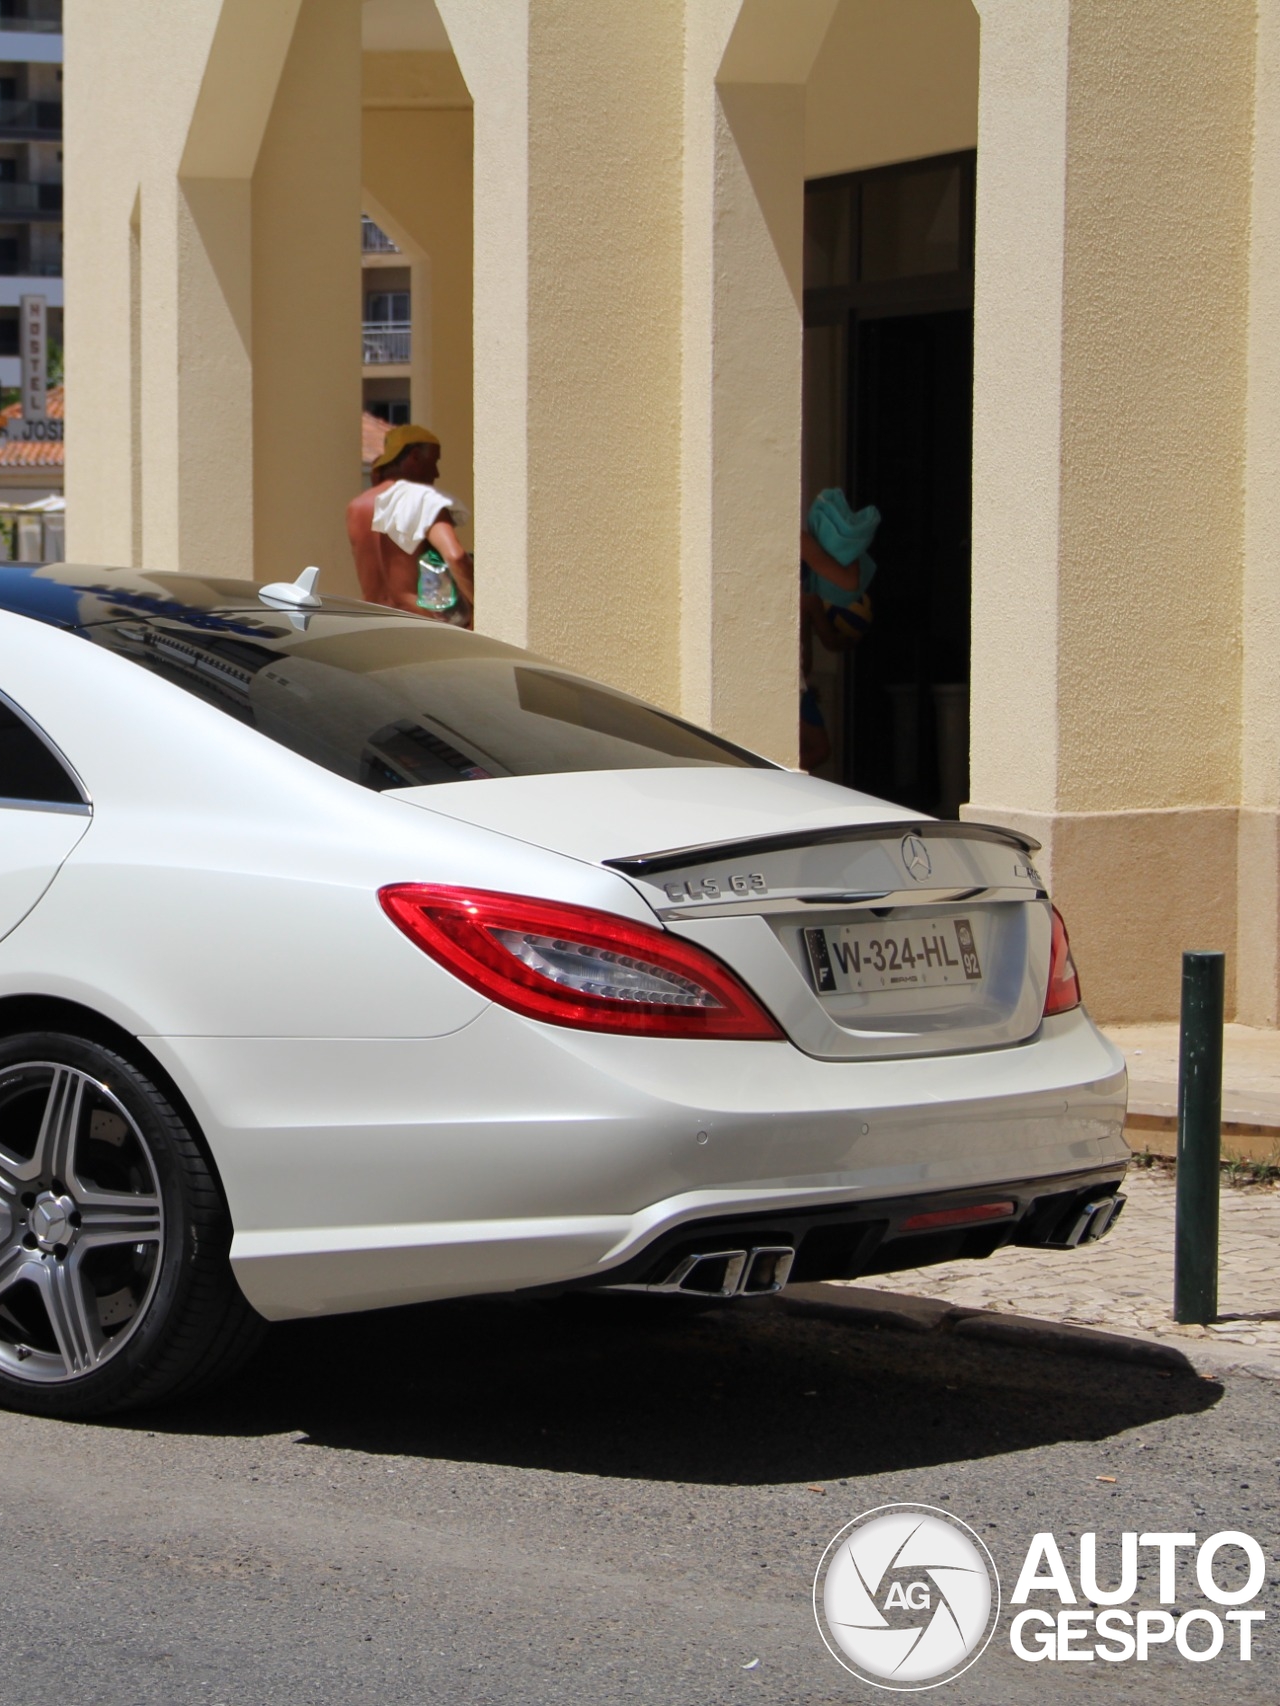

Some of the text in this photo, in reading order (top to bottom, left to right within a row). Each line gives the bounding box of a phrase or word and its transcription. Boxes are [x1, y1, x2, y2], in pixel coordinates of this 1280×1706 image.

[29, 303, 41, 410] HOSTEL
[664, 873, 767, 900] CLS 63
[832, 935, 959, 974] W-324-HL
[963, 953, 979, 974] 92
[819, 967, 829, 982] F
